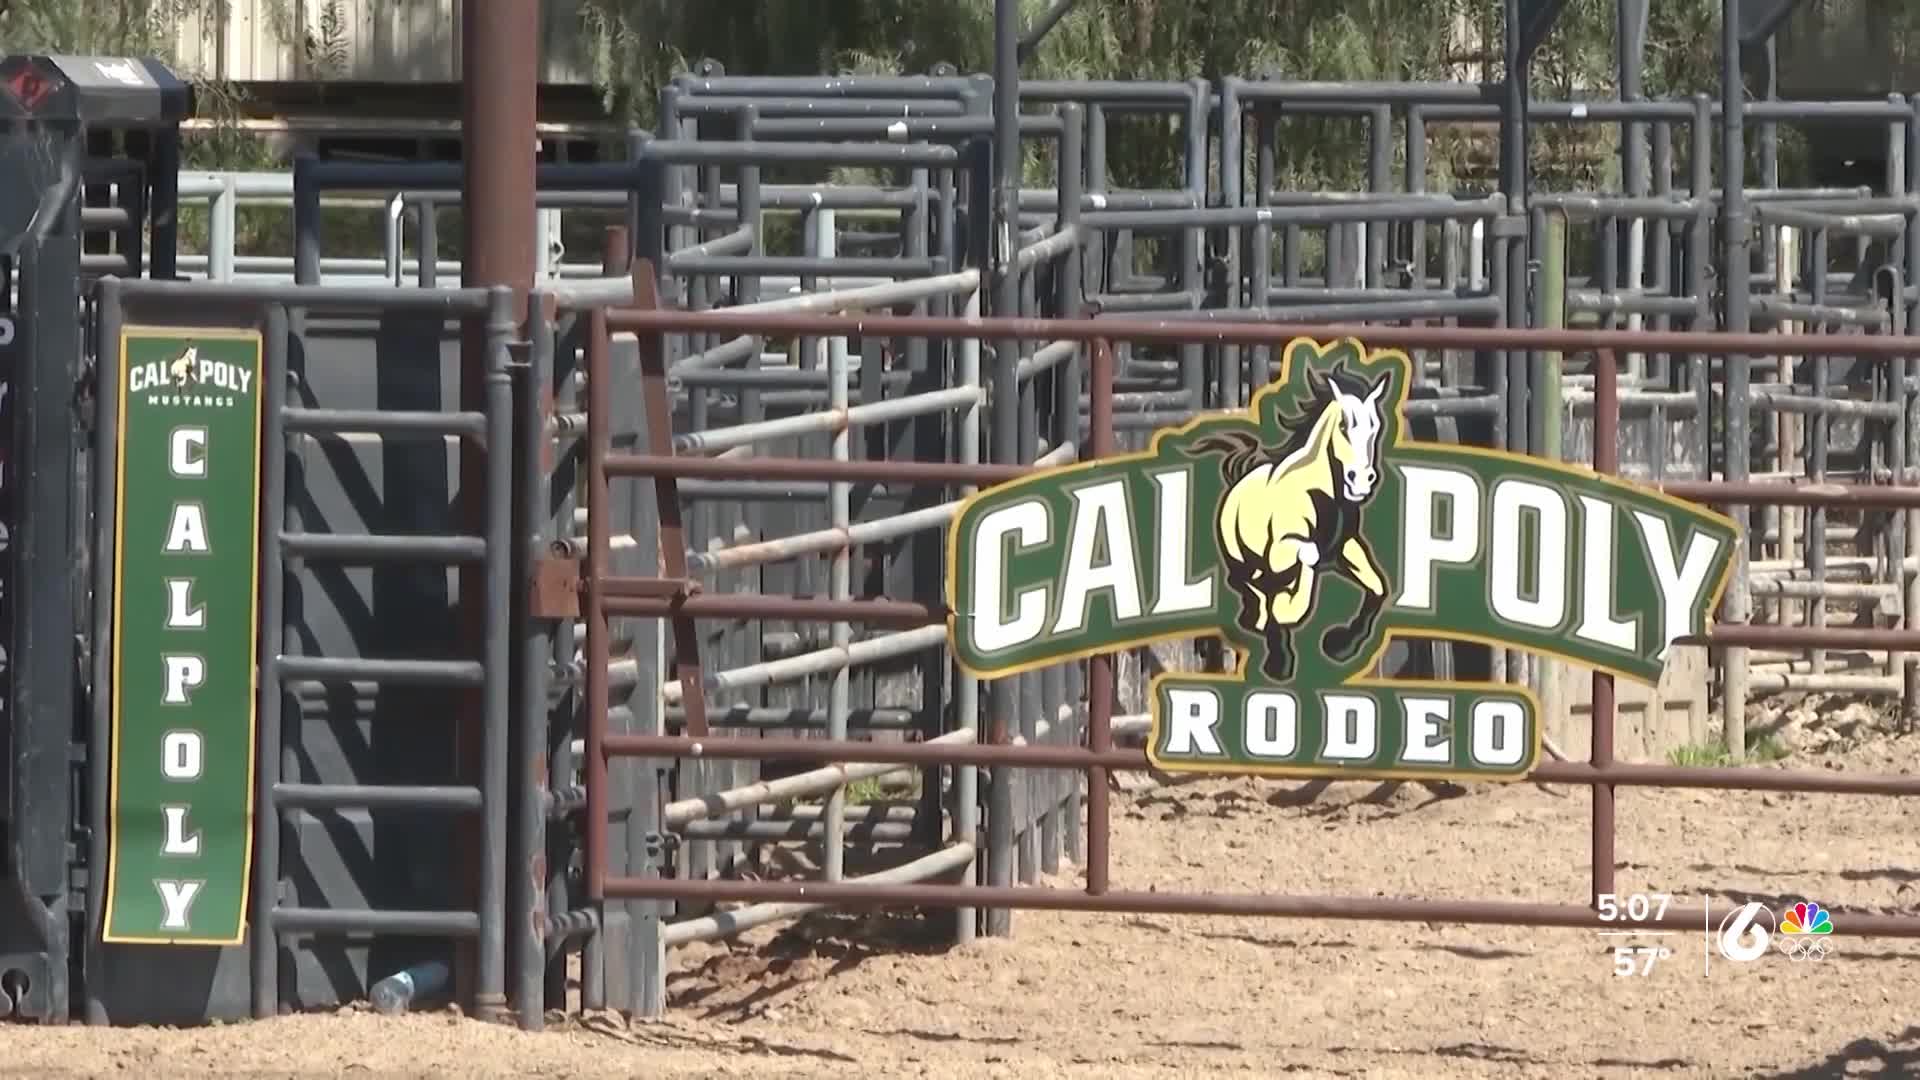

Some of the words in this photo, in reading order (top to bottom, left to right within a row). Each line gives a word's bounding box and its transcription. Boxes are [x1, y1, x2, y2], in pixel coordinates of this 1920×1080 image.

[129, 360, 171, 393] CAL
[199, 359, 252, 394] POLY
[147, 395, 234, 407] MUSTANGS
[971, 466, 1216, 653] CAL
[1389, 461, 1724, 662] POLY
[1163, 686, 1527, 767] RODEO
